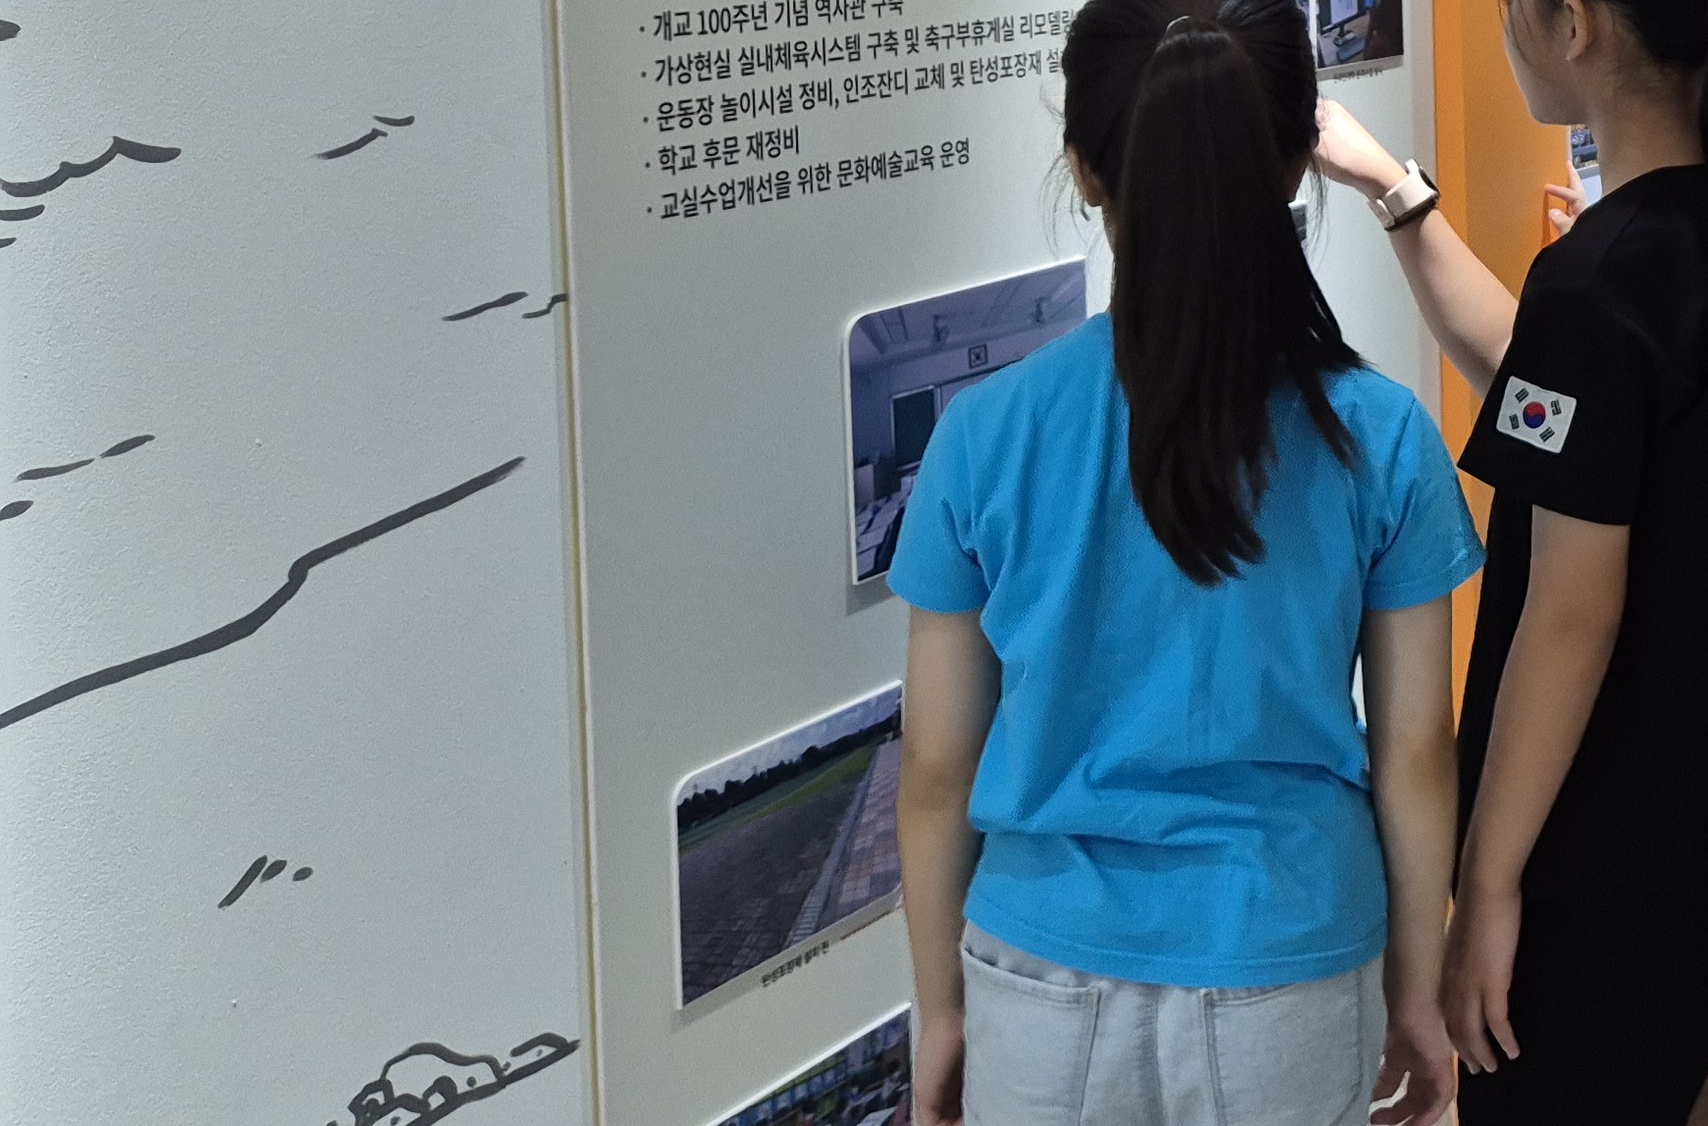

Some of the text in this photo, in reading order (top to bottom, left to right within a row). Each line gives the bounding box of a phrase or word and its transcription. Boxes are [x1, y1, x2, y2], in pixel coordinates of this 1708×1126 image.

[654, 9, 692, 41] 개교
[697, 0, 768, 35] 100주년
[655, 49, 731, 86] 가상현실
[737, 34, 860, 76] 실내체육시스템
[866, 29, 899, 57] 구축
[904, 27, 920, 54] 및
[924, 15, 1015, 50] 축구부휴게실
[656, 97, 713, 133] 운동장
[720, 84, 793, 123] 놀이시설
[799, 83, 840, 111] 정비,
[843, 74, 909, 104] 인조잔디
[914, 65, 944, 92] 교체
[950, 61, 966, 87] 및
[970, 48, 1042, 85] 탄성포장재
[658, 126, 800, 174] 학교 후문 재정비
[661, 138, 970, 220] 교실수업개선을 위한 문화예술교육 운영
